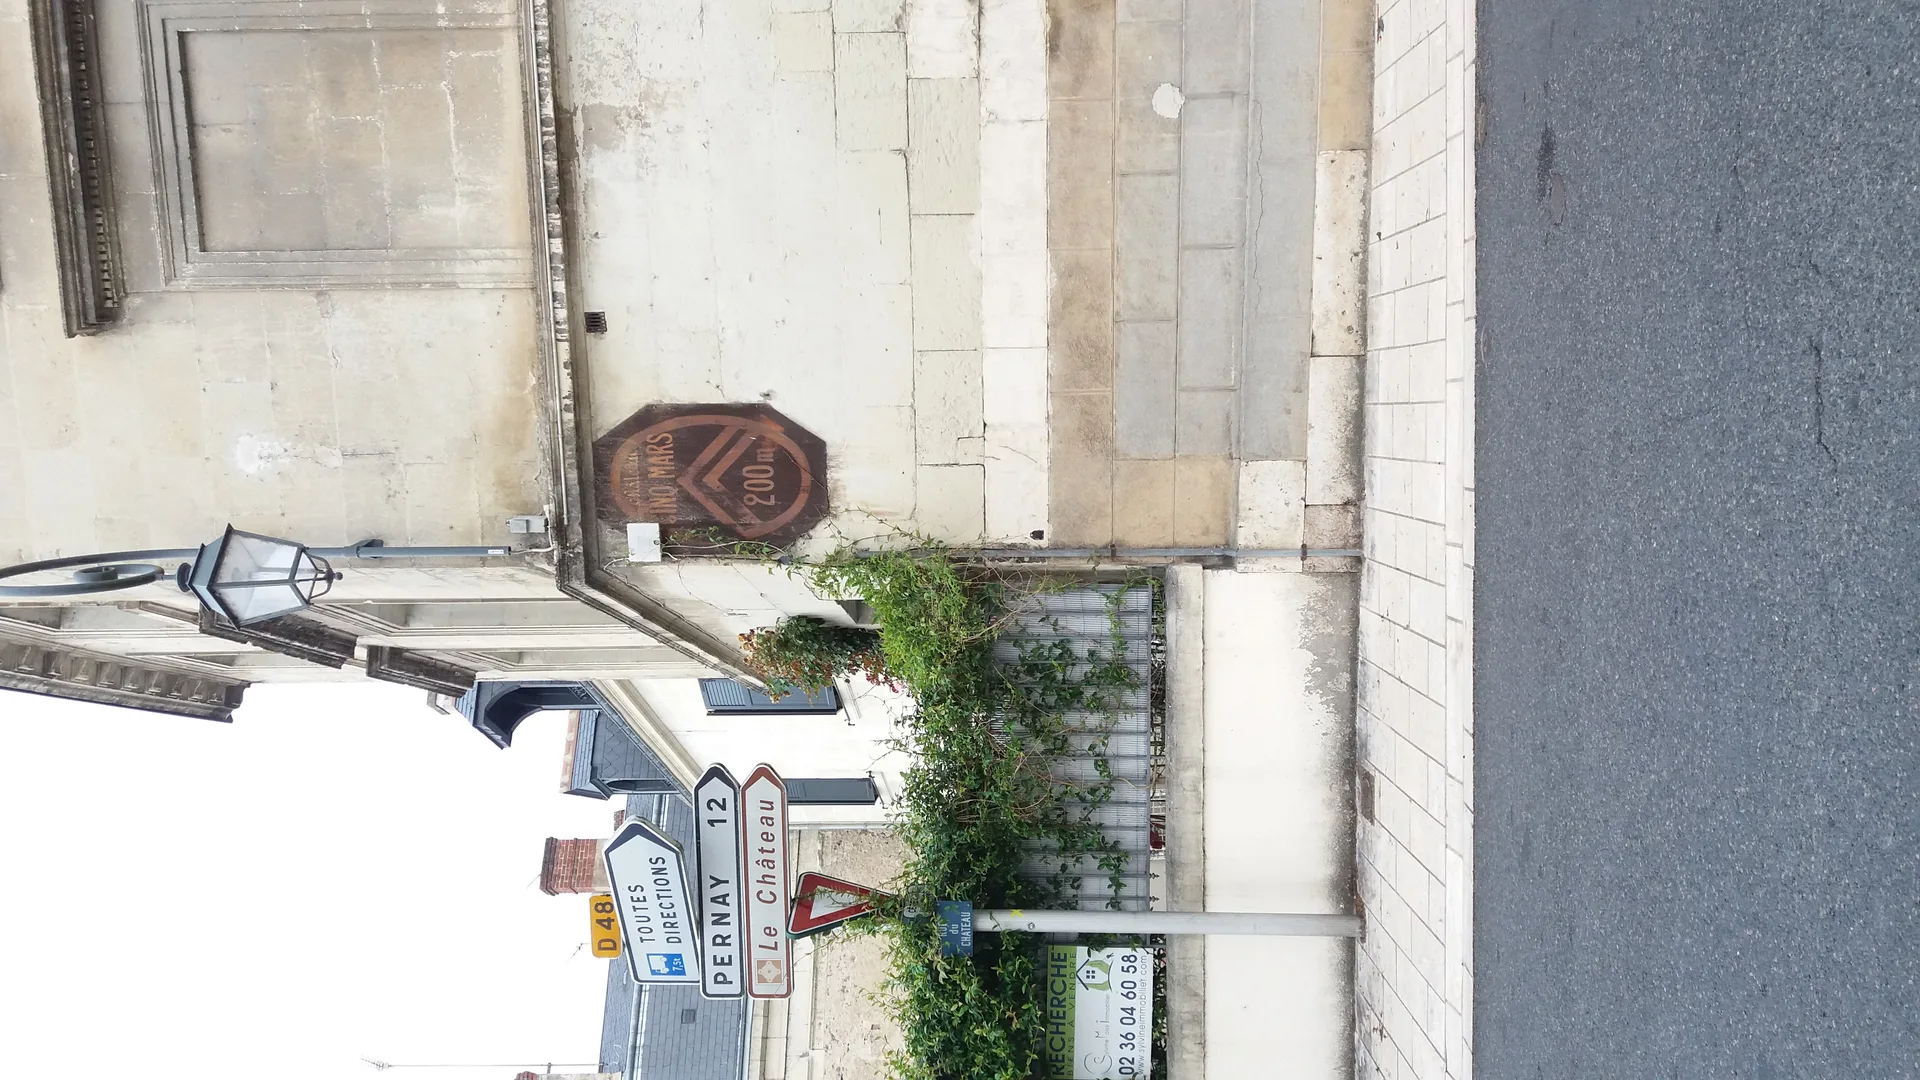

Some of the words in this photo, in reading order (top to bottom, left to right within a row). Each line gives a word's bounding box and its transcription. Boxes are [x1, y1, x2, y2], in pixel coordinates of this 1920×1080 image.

[646, 431, 675, 479] MARS
[706, 797, 727, 828] 12
[755, 799, 777, 904] Château
[594, 901, 615, 931] 48
[627, 884, 656, 944] TOUTES
[648, 856, 682, 944] DIRECTIONS
[597, 939, 617, 951] D
[709, 874, 733, 985] PERNAY
[758, 926, 779, 951] Le
[949, 923, 959, 935] du
[960, 911, 971, 947] CHATEAU
[1068, 952, 1076, 1010] VENDRE
[1121, 954, 1137, 975] 58
[1120, 980, 1137, 1000] 60
[1048, 952, 1067, 1076] RECHERCHE
[1119, 1006, 1136, 1026] 04
[1137, 955, 1148, 1075] www.sylvineimmobilier.com
[1067, 1036, 1075, 1077] BIENS
[1119, 1032, 1136, 1051] 36
[1118, 1057, 1135, 1075] 02
